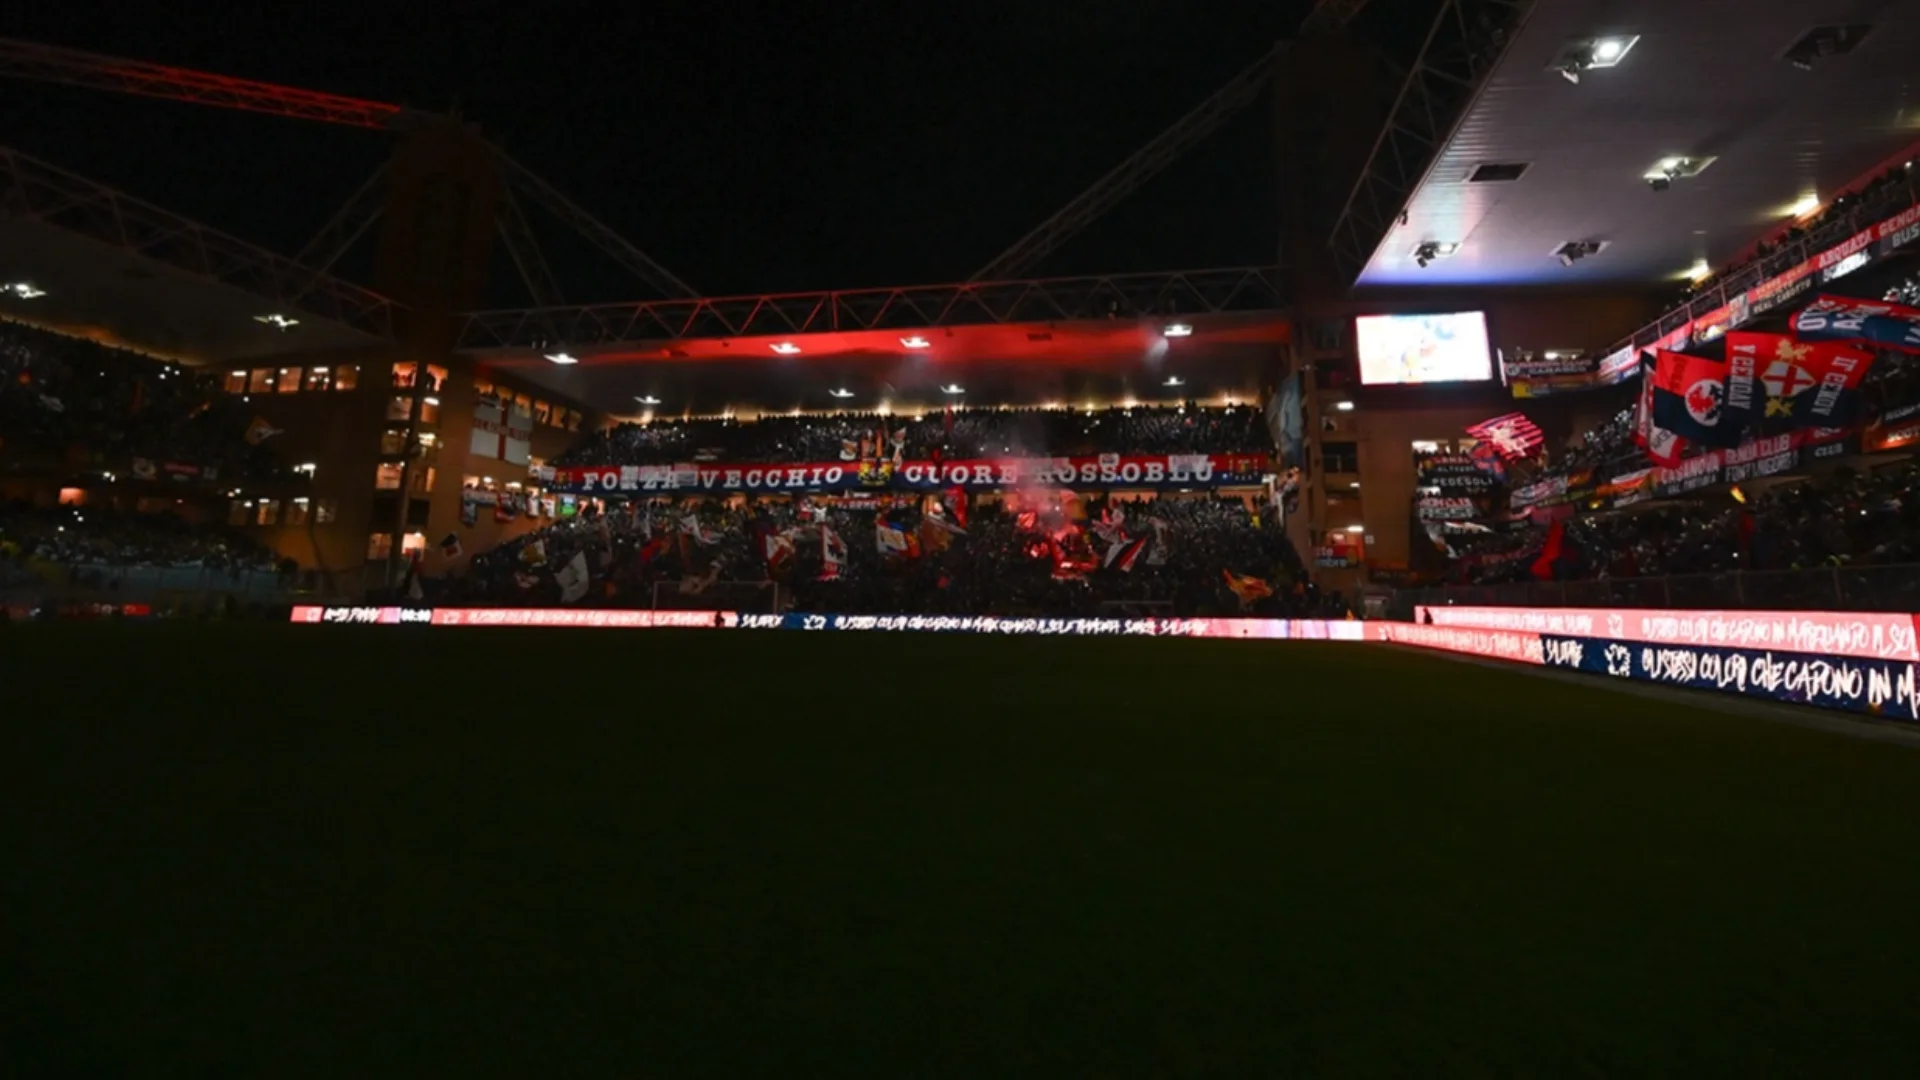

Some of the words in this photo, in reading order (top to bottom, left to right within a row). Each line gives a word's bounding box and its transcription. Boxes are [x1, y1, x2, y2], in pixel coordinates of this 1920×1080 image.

[700, 467, 844, 488] VECCHIO
[905, 464, 1018, 484] CUORE
[1034, 461, 1216, 484] ROSSOBLU
[1867, 662, 1892, 705] IN
[1896, 663, 1920, 720] M
